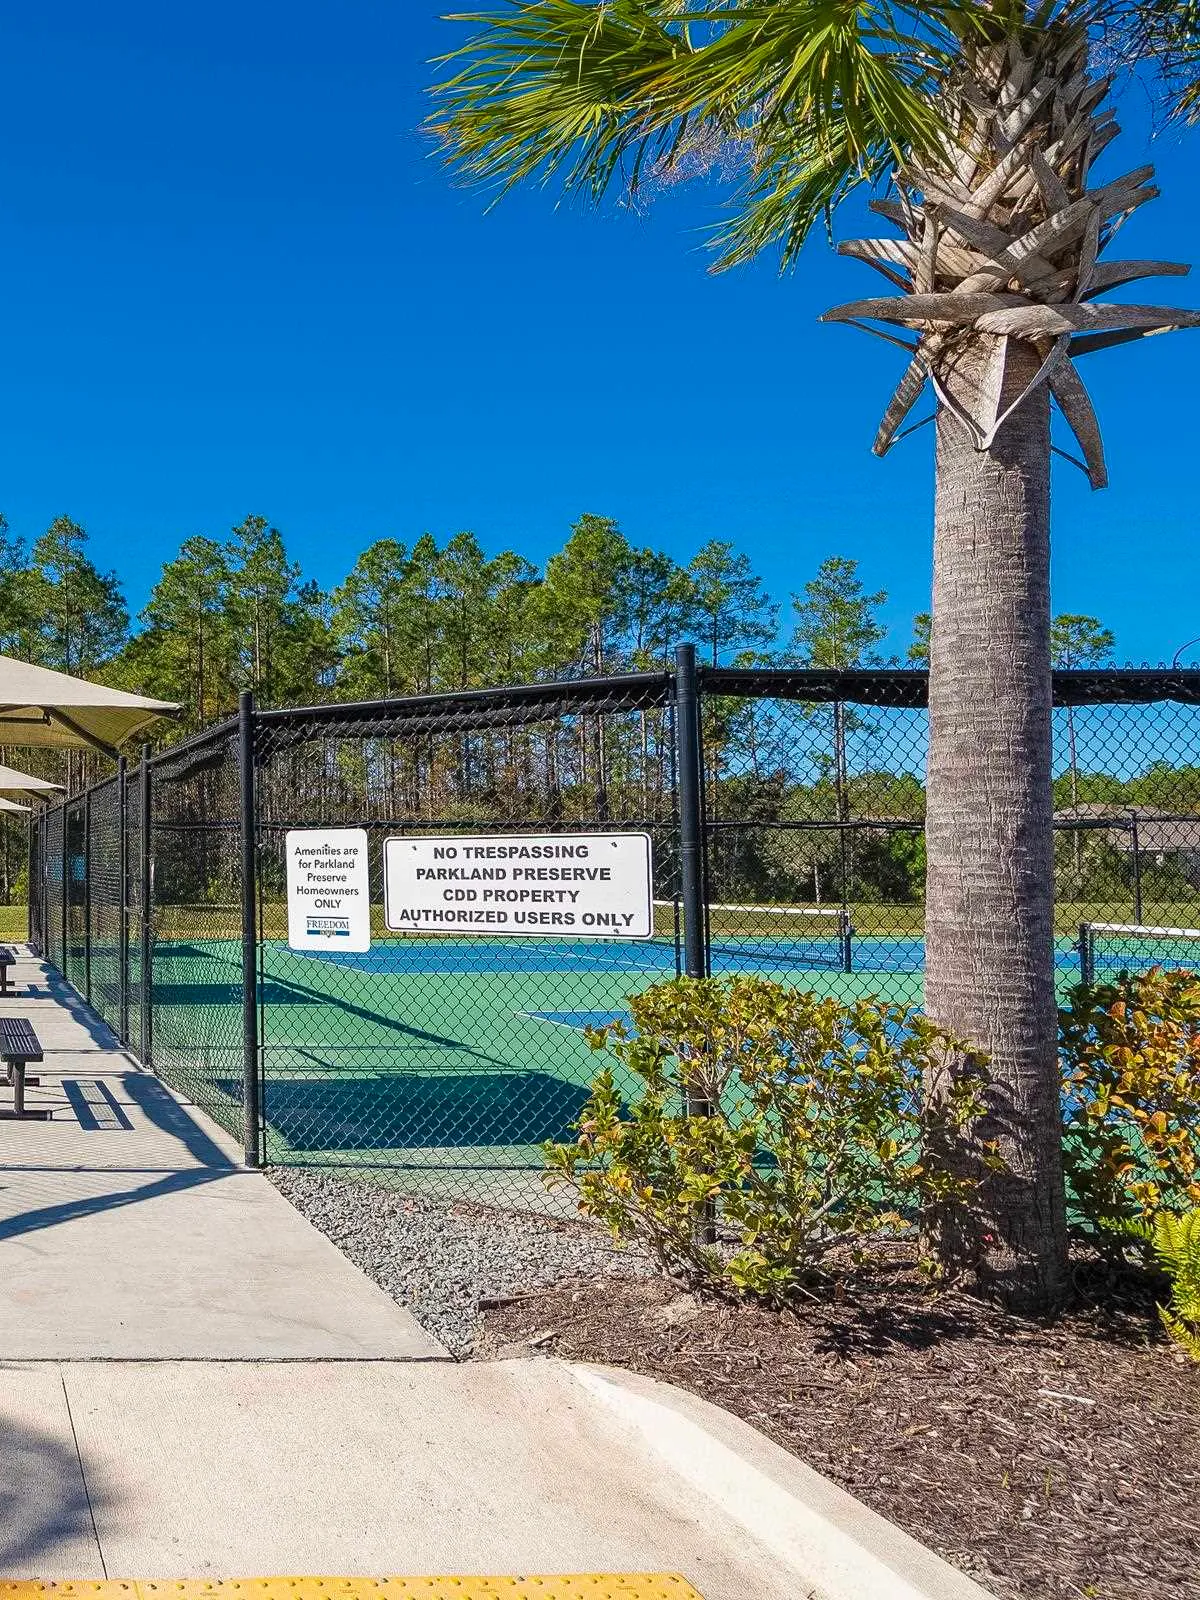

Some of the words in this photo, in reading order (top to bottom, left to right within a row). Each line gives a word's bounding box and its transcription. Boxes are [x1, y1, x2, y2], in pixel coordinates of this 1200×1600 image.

[294, 846, 341, 856] Amenities
[343, 847, 359, 856] are
[433, 846, 457, 859] NO
[463, 845, 589, 859] TRESPASSING
[298, 859, 311, 869] for
[314, 859, 355, 869] Parkland
[307, 872, 347, 882] Preserve
[416, 867, 506, 881] PARKLAND
[512, 867, 611, 881] PRESERVE
[296, 885, 359, 896] Homeowners
[443, 888, 477, 901] CDD
[483, 889, 580, 903] PROPERTY
[314, 898, 342, 909] ONLY
[400, 909, 508, 924] AUTHORIZED
[514, 911, 576, 925] USERS
[581, 912, 635, 927] ONLY
[306, 919, 349, 929] FREEDOM
